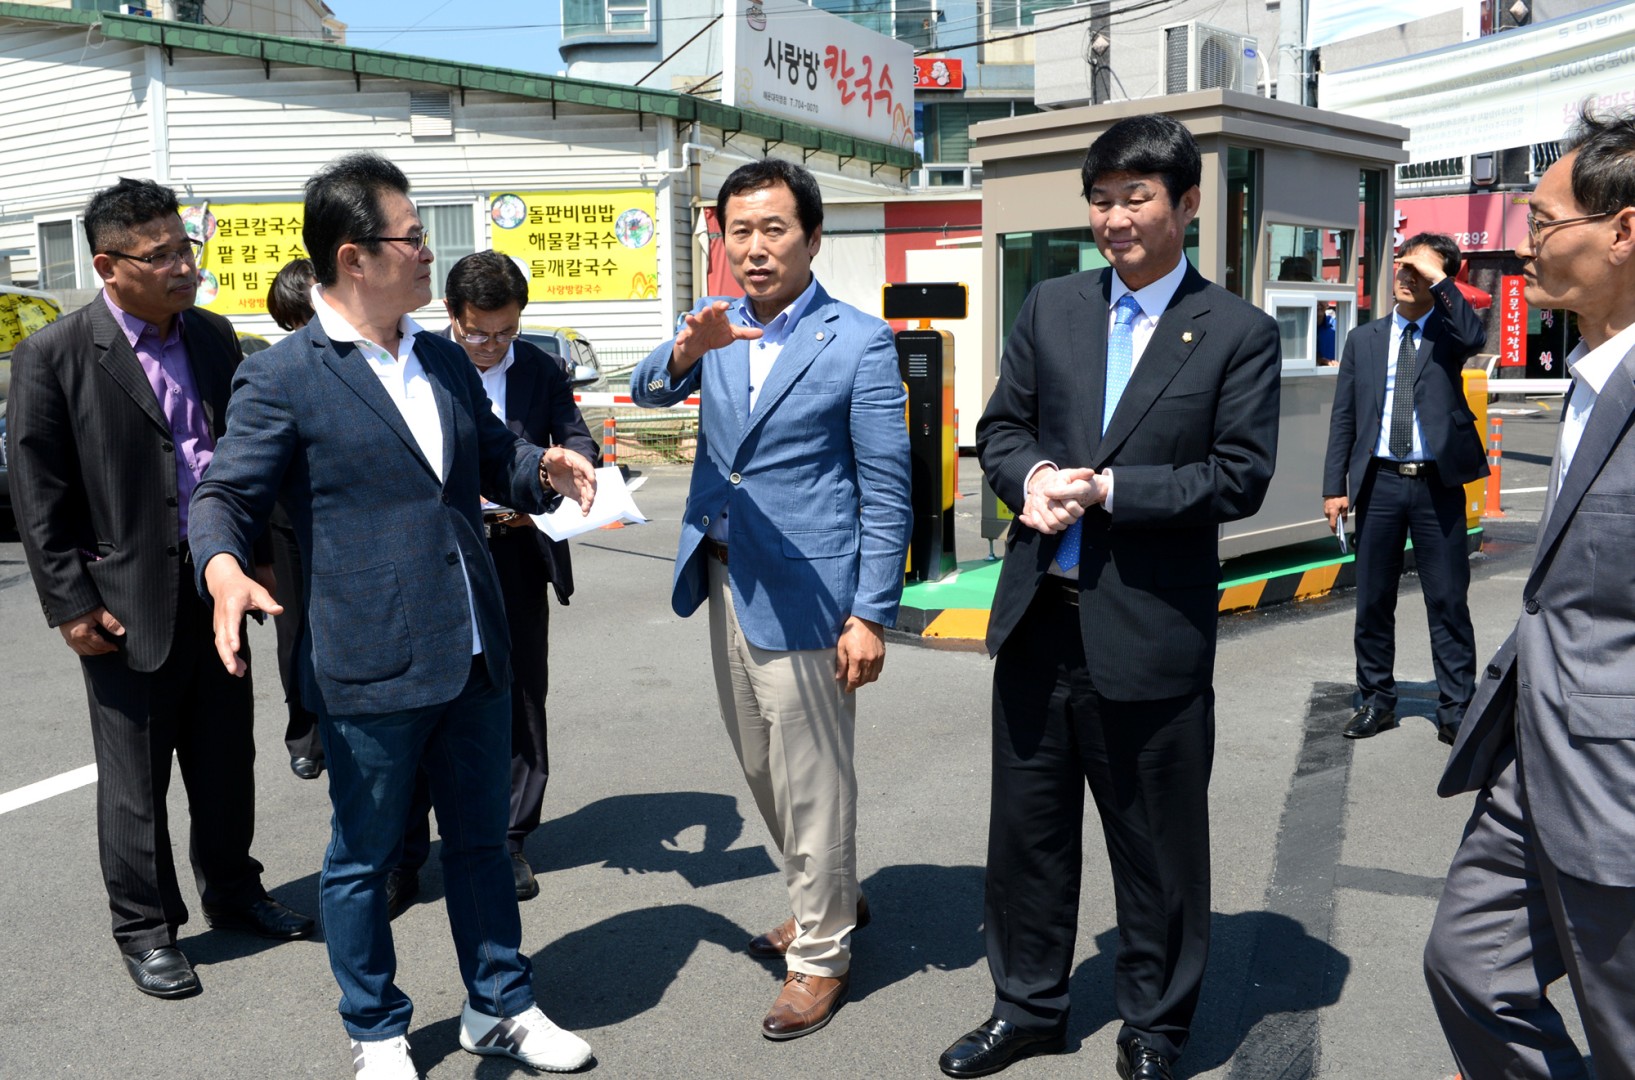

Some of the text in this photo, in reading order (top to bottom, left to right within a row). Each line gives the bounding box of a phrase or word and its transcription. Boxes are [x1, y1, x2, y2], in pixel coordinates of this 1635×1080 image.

[764, 37, 894, 118] 사랑방 칼국수
[528, 204, 615, 225] 돌판비빔밥
[216, 216, 302, 237] 얼큰칼국수
[528, 231, 617, 251] 해물칼국수
[1455, 231, 1489, 246] 7892
[529, 258, 618, 278] 들깨칼국수
[547, 284, 602, 296] 사랑방칼국수
[238, 298, 266, 309] 사랑방
[1506, 287, 1521, 362] 소문난막창집
